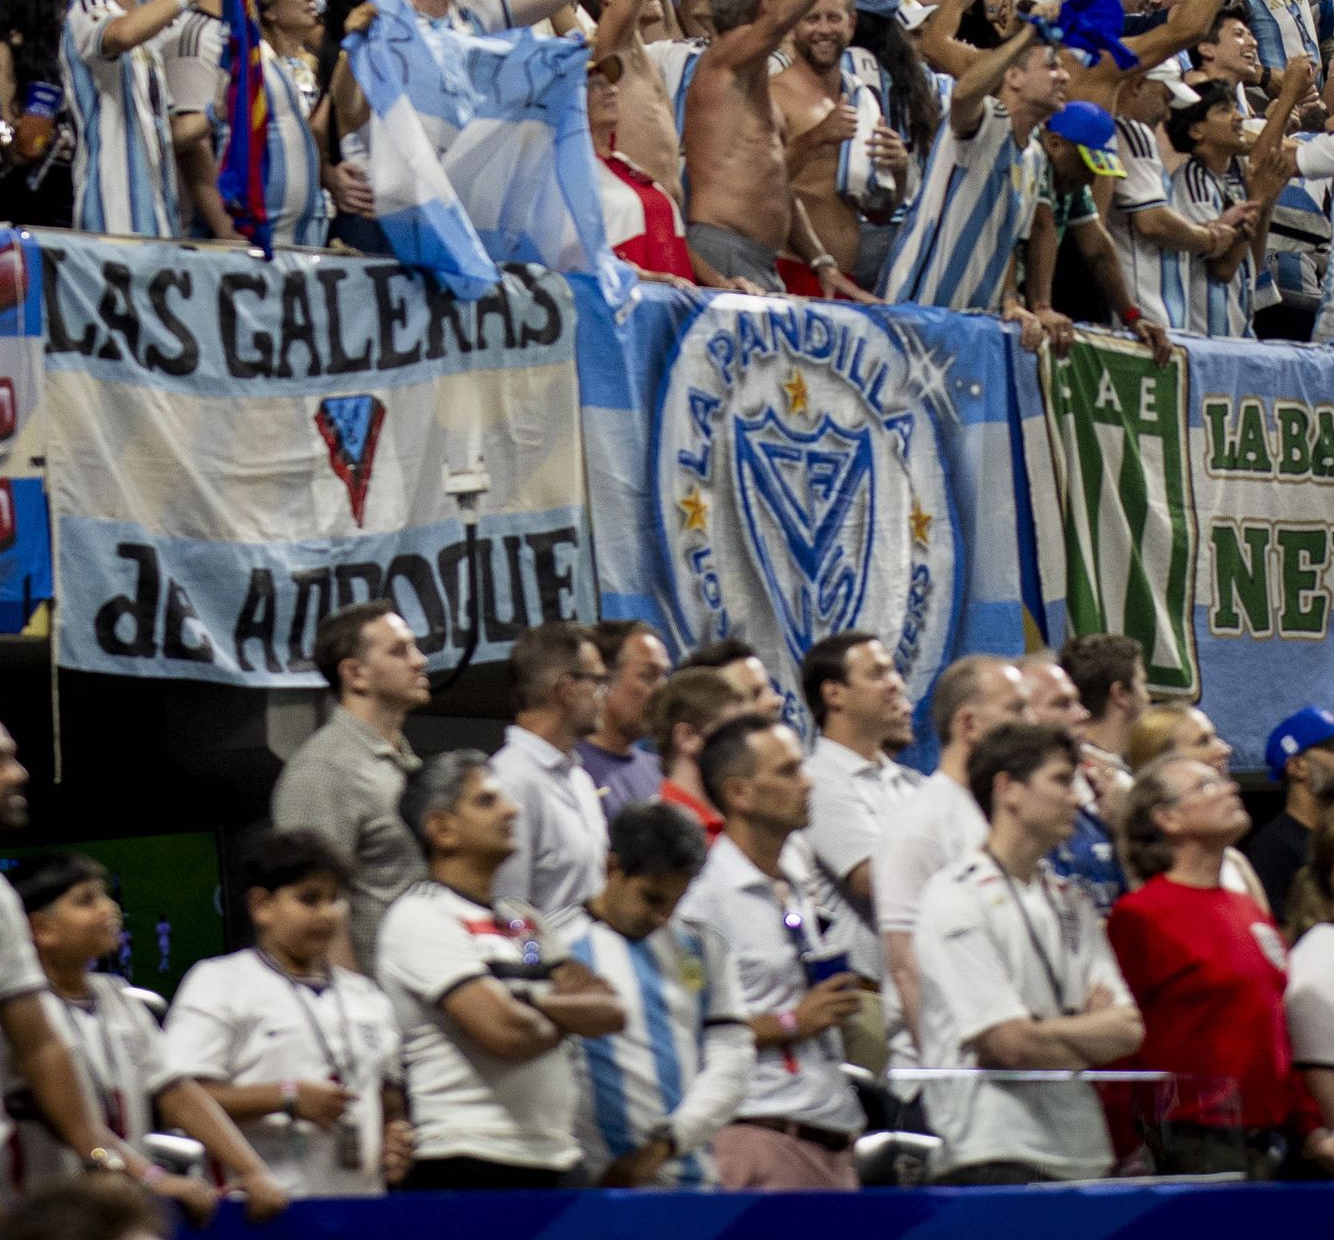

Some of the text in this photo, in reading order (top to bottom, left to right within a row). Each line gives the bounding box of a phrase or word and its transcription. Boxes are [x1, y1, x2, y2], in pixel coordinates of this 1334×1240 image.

[41, 247, 201, 375] LAS
[678, 306, 915, 477] LA PANDILLA
